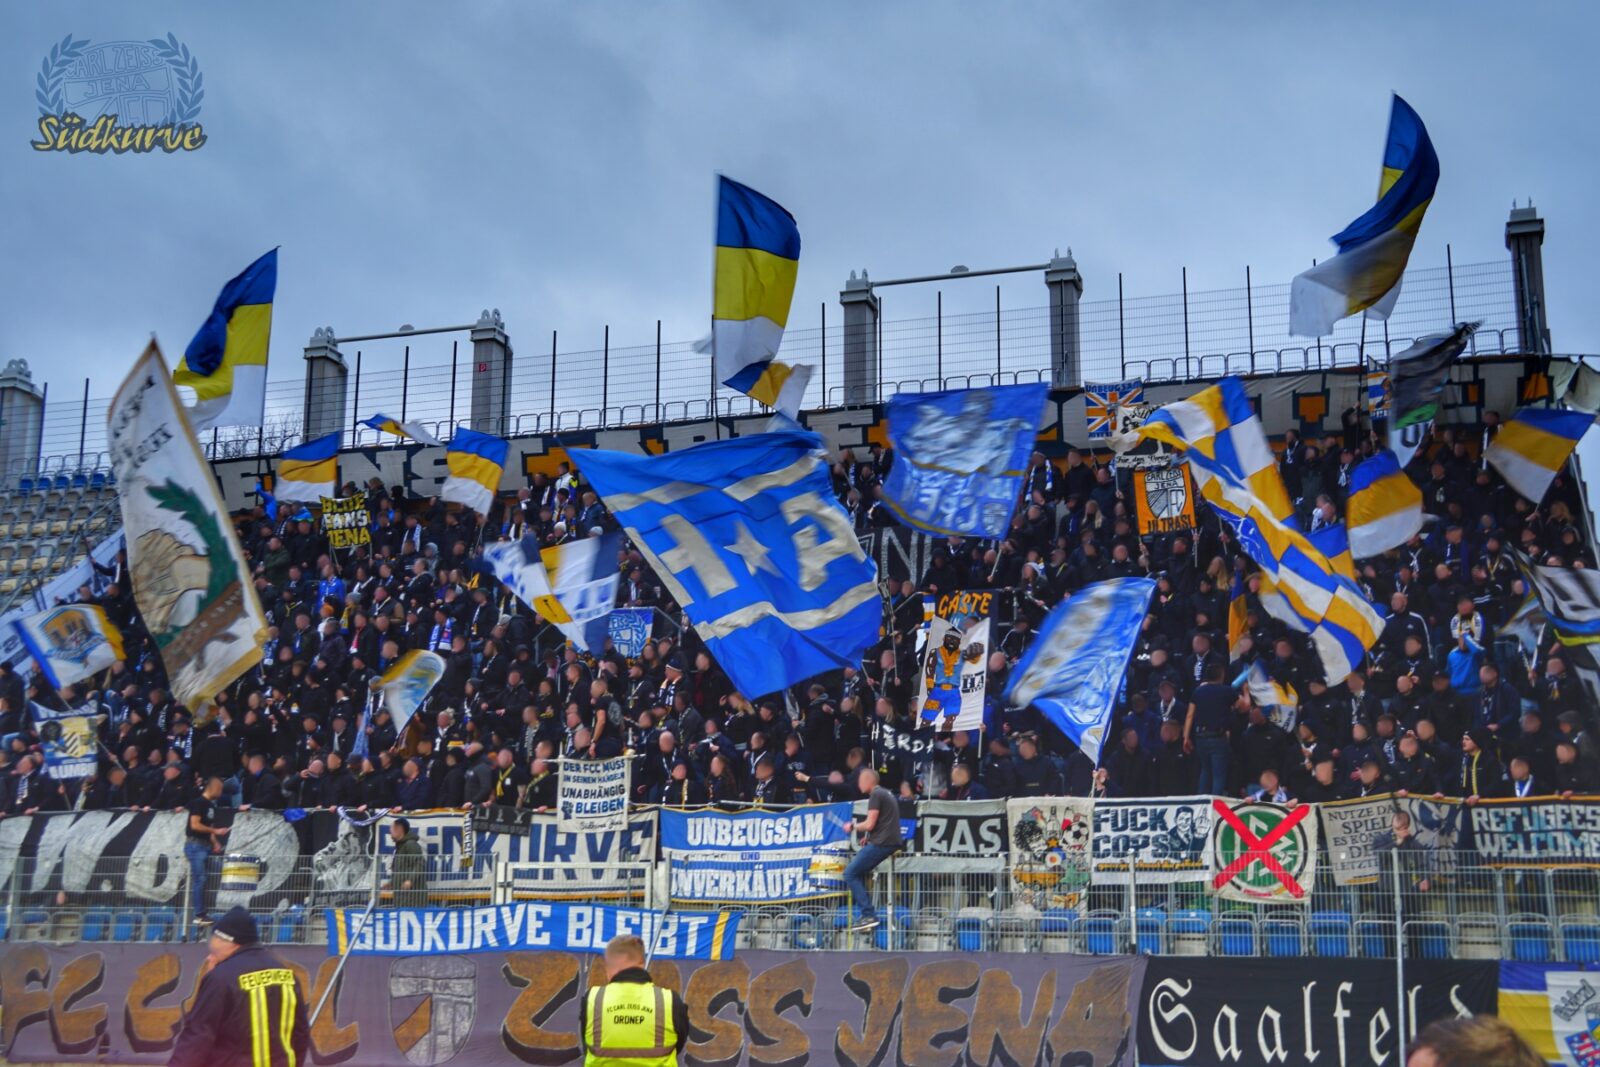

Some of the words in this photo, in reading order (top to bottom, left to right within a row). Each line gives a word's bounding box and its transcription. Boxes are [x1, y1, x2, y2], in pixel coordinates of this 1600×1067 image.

[326, 527, 371, 547] JENA
[937, 590, 993, 618] GÄSTE
[563, 761, 580, 772] DER
[583, 763, 601, 773] FCC
[603, 759, 625, 771] MUSS
[561, 783, 625, 799] UNABHÄNGIG
[575, 798, 625, 814] BLEIBEN
[1328, 806, 1375, 821] NUTZE
[1092, 807, 1169, 832] FUCK
[1342, 819, 1393, 834] SPIEL
[1471, 804, 1600, 833] REFUGEES
[686, 812, 825, 847] UNBEUGSAM
[1092, 833, 1170, 858] COPS
[1333, 836, 1348, 846] ES
[1474, 831, 1600, 858] WELCOME
[740, 851, 760, 861] UND
[671, 863, 824, 899] NVERKÄUFL
[350, 903, 551, 953] SÜDKURVE
[566, 908, 709, 958] BLEIBT
[240, 971, 294, 989] FEUERWEHR
[613, 1003, 626, 1012] CARL
[835, 956, 1132, 1067] JENA
